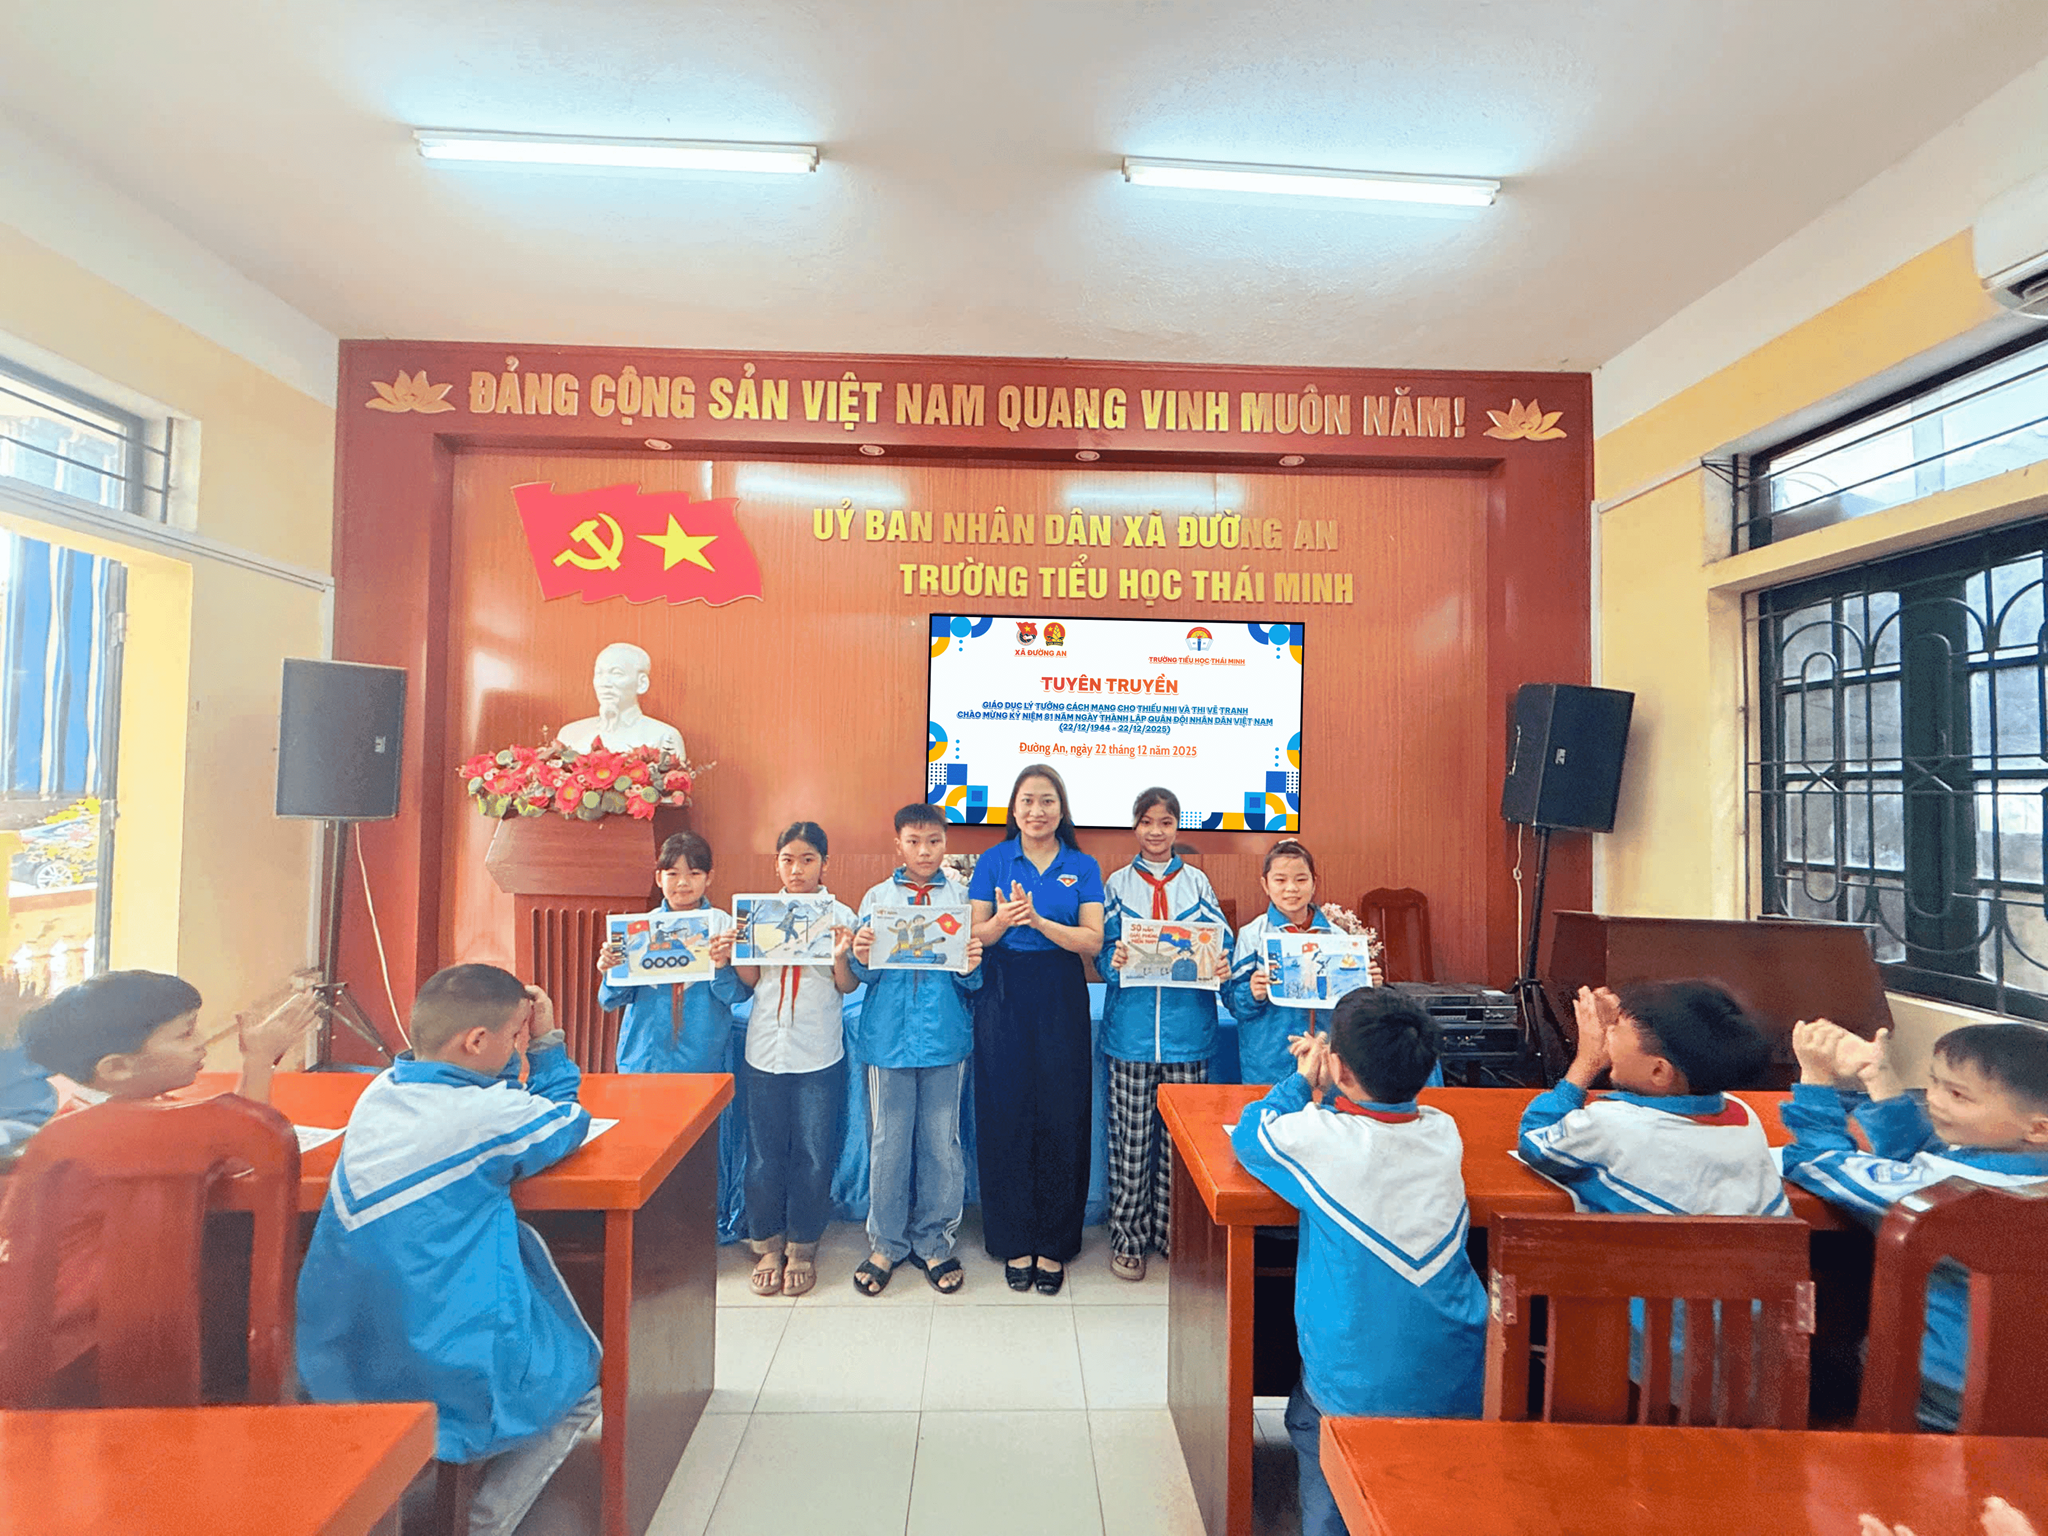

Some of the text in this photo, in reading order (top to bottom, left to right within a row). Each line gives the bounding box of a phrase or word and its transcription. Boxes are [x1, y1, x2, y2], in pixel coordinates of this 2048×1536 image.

[469, 355, 1466, 438] ĐẢNG CỘNG SẢN VIỆT NAM QUANG VINH MUÔN NĂM!
[813, 497, 1338, 550] UỶ BAN NHÂN DÂN XÃ ĐƯỜNG AN
[900, 553, 1354, 606] TRƯỜNG TIỂU HỌC THÁI MINH
[1014, 648, 1026, 657] XÃ
[1027, 648, 1055, 658] ĐƯỜNG
[1149, 655, 1246, 667] TRƯỜNG TIỂU HỌC THÁI MINH
[1041, 673, 1179, 695] TUYÊN TRUYỀN
[981, 700, 1004, 709] GIÁO
[1004, 701, 1023, 712] DỤC
[1066, 702, 1090, 712] CÁCH
[1090, 703, 1116, 714] MẠNG
[1117, 705, 1136, 713] CHO
[1137, 703, 1162, 714] THIẾU
[1162, 706, 1178, 714] NHI
[1178, 704, 1191, 715] VÀ
[1191, 706, 1206, 714] THI
[1220, 707, 1249, 716] TRANH
[956, 710, 981, 719] CHÀO
[982, 710, 1008, 720] MỪNG
[1022, 711, 1043, 722] NIỆM
[1044, 713, 1053, 721] 81
[1075, 712, 1098, 722] NGÀY
[1099, 713, 1129, 723] THÀNH
[1130, 713, 1147, 725] LẬP
[1148, 714, 1172, 724] QUÂN
[1173, 714, 1188, 726] ĐỘI
[1189, 714, 1214, 724] NHÂN
[1214, 715, 1233, 725] DÂN
[1233, 715, 1253, 727] VIỆT
[1254, 717, 1274, 726] NAM
[1059, 723, 1111, 733] (22/12/1944
[1118, 725, 1171, 735] 22/12/2025)
[1019, 742, 1197, 758] Đường An, ngày 22 tháng 12 năm 2025
[1130, 924, 1142, 932] 50
